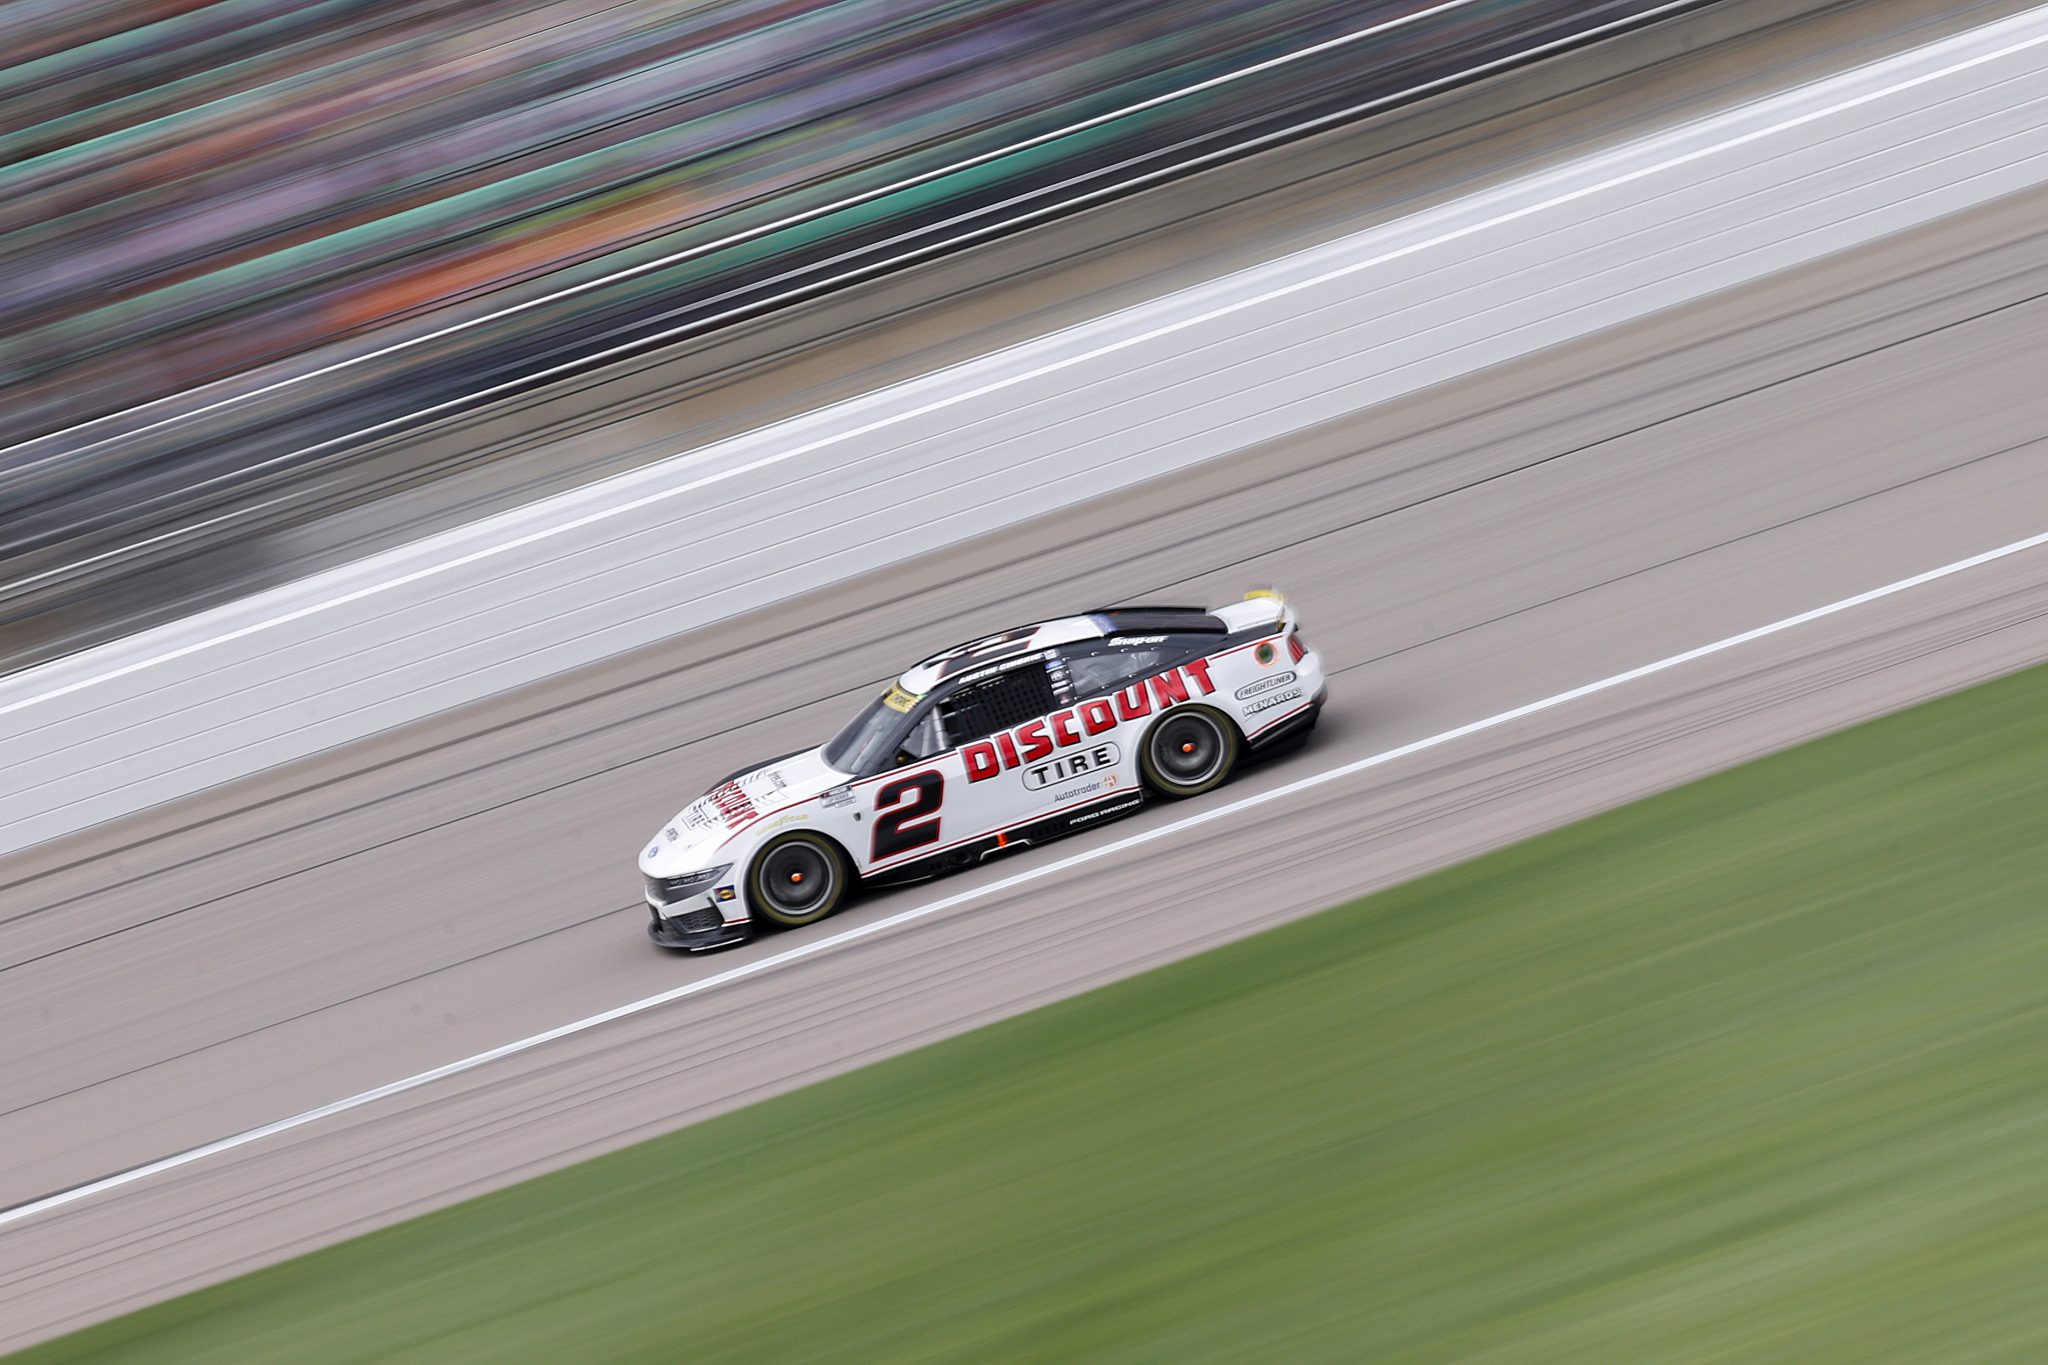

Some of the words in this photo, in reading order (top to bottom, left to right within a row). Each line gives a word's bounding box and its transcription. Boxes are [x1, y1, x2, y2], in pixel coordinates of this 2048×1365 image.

[1240, 674, 1291, 696] FREIGHTLINER
[1242, 688, 1302, 716] MENARDS
[960, 657, 1216, 784] DISCOUNT
[1031, 746, 1111, 785] TIRE
[1054, 782, 1100, 802] Autotrader
[869, 769, 944, 863] 2
[1070, 811, 1099, 825] FORD
[1099, 799, 1140, 816] RACING
